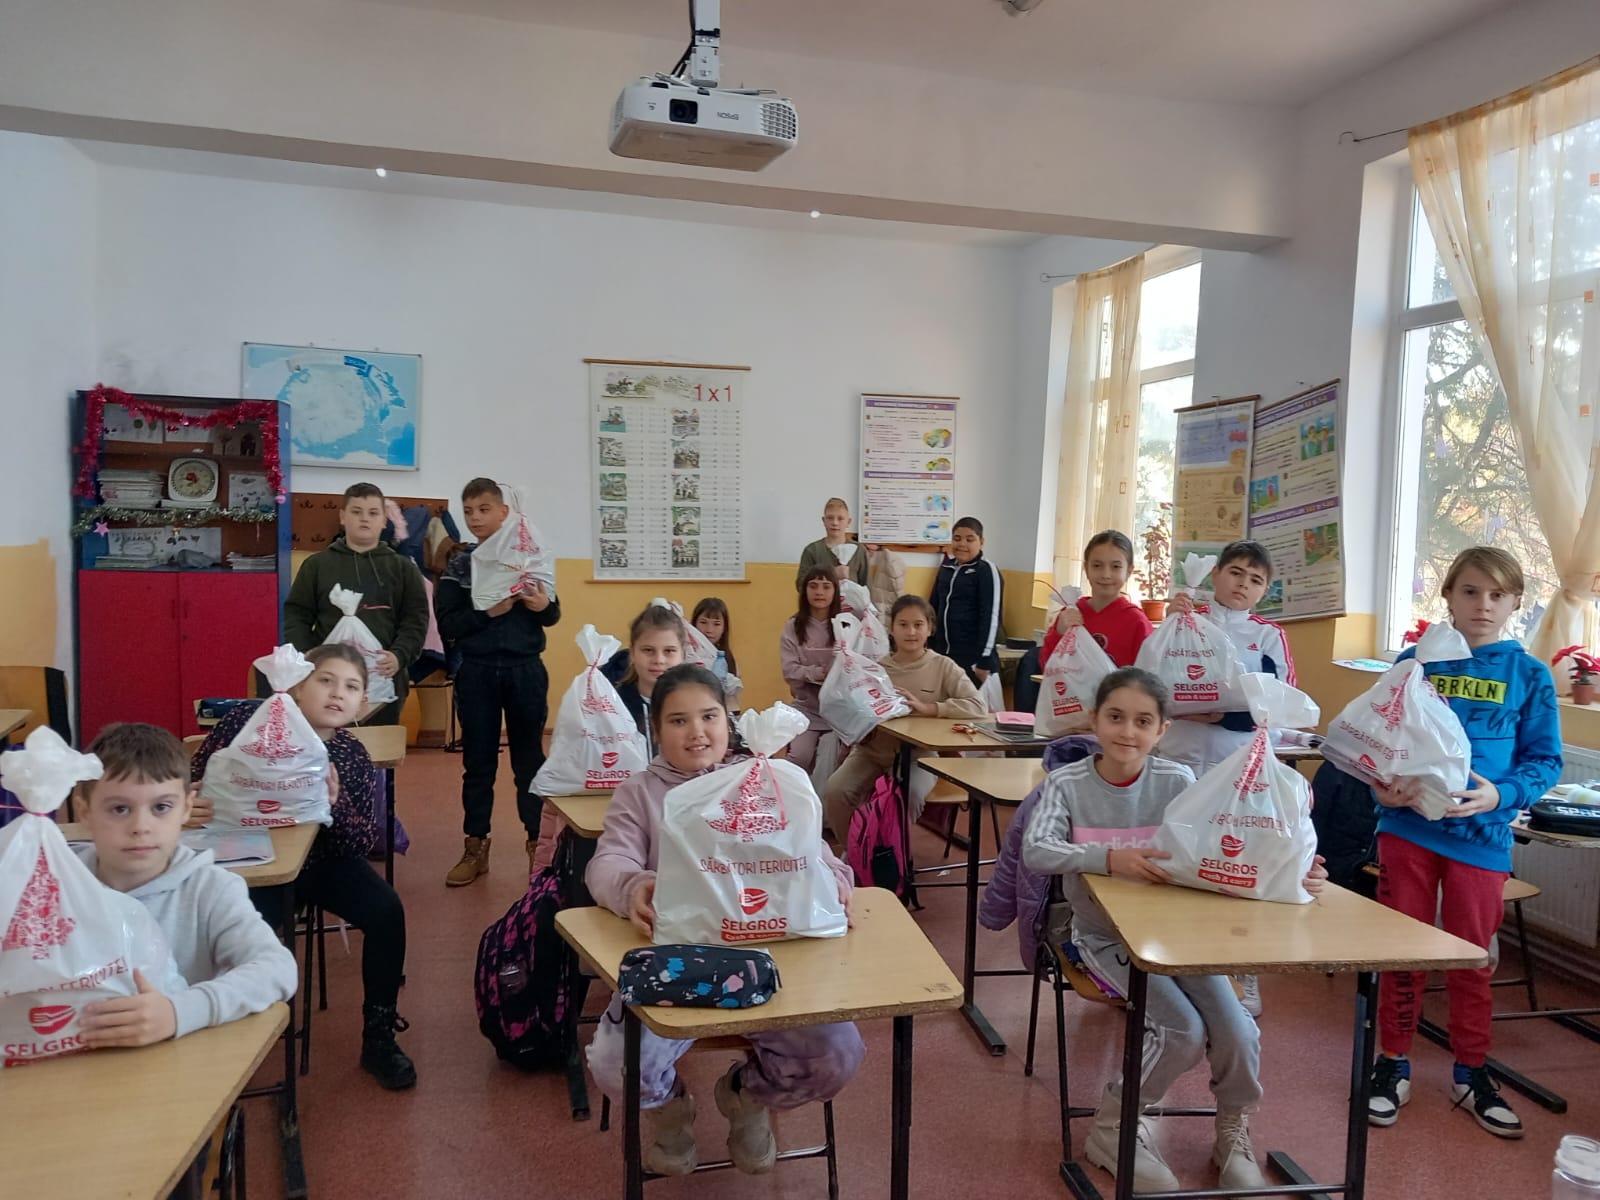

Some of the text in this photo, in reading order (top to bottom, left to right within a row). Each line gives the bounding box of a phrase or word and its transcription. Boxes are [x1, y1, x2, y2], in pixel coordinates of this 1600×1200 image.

[1173, 682, 1218, 692] SELGROS
[1436, 678, 1498, 699] BRKLN
[585, 769, 631, 779] SELGROS
[240, 816, 296, 827] SELGROS
[1200, 857, 1259, 876] SELGROS
[721, 917, 788, 931] SELGROS
